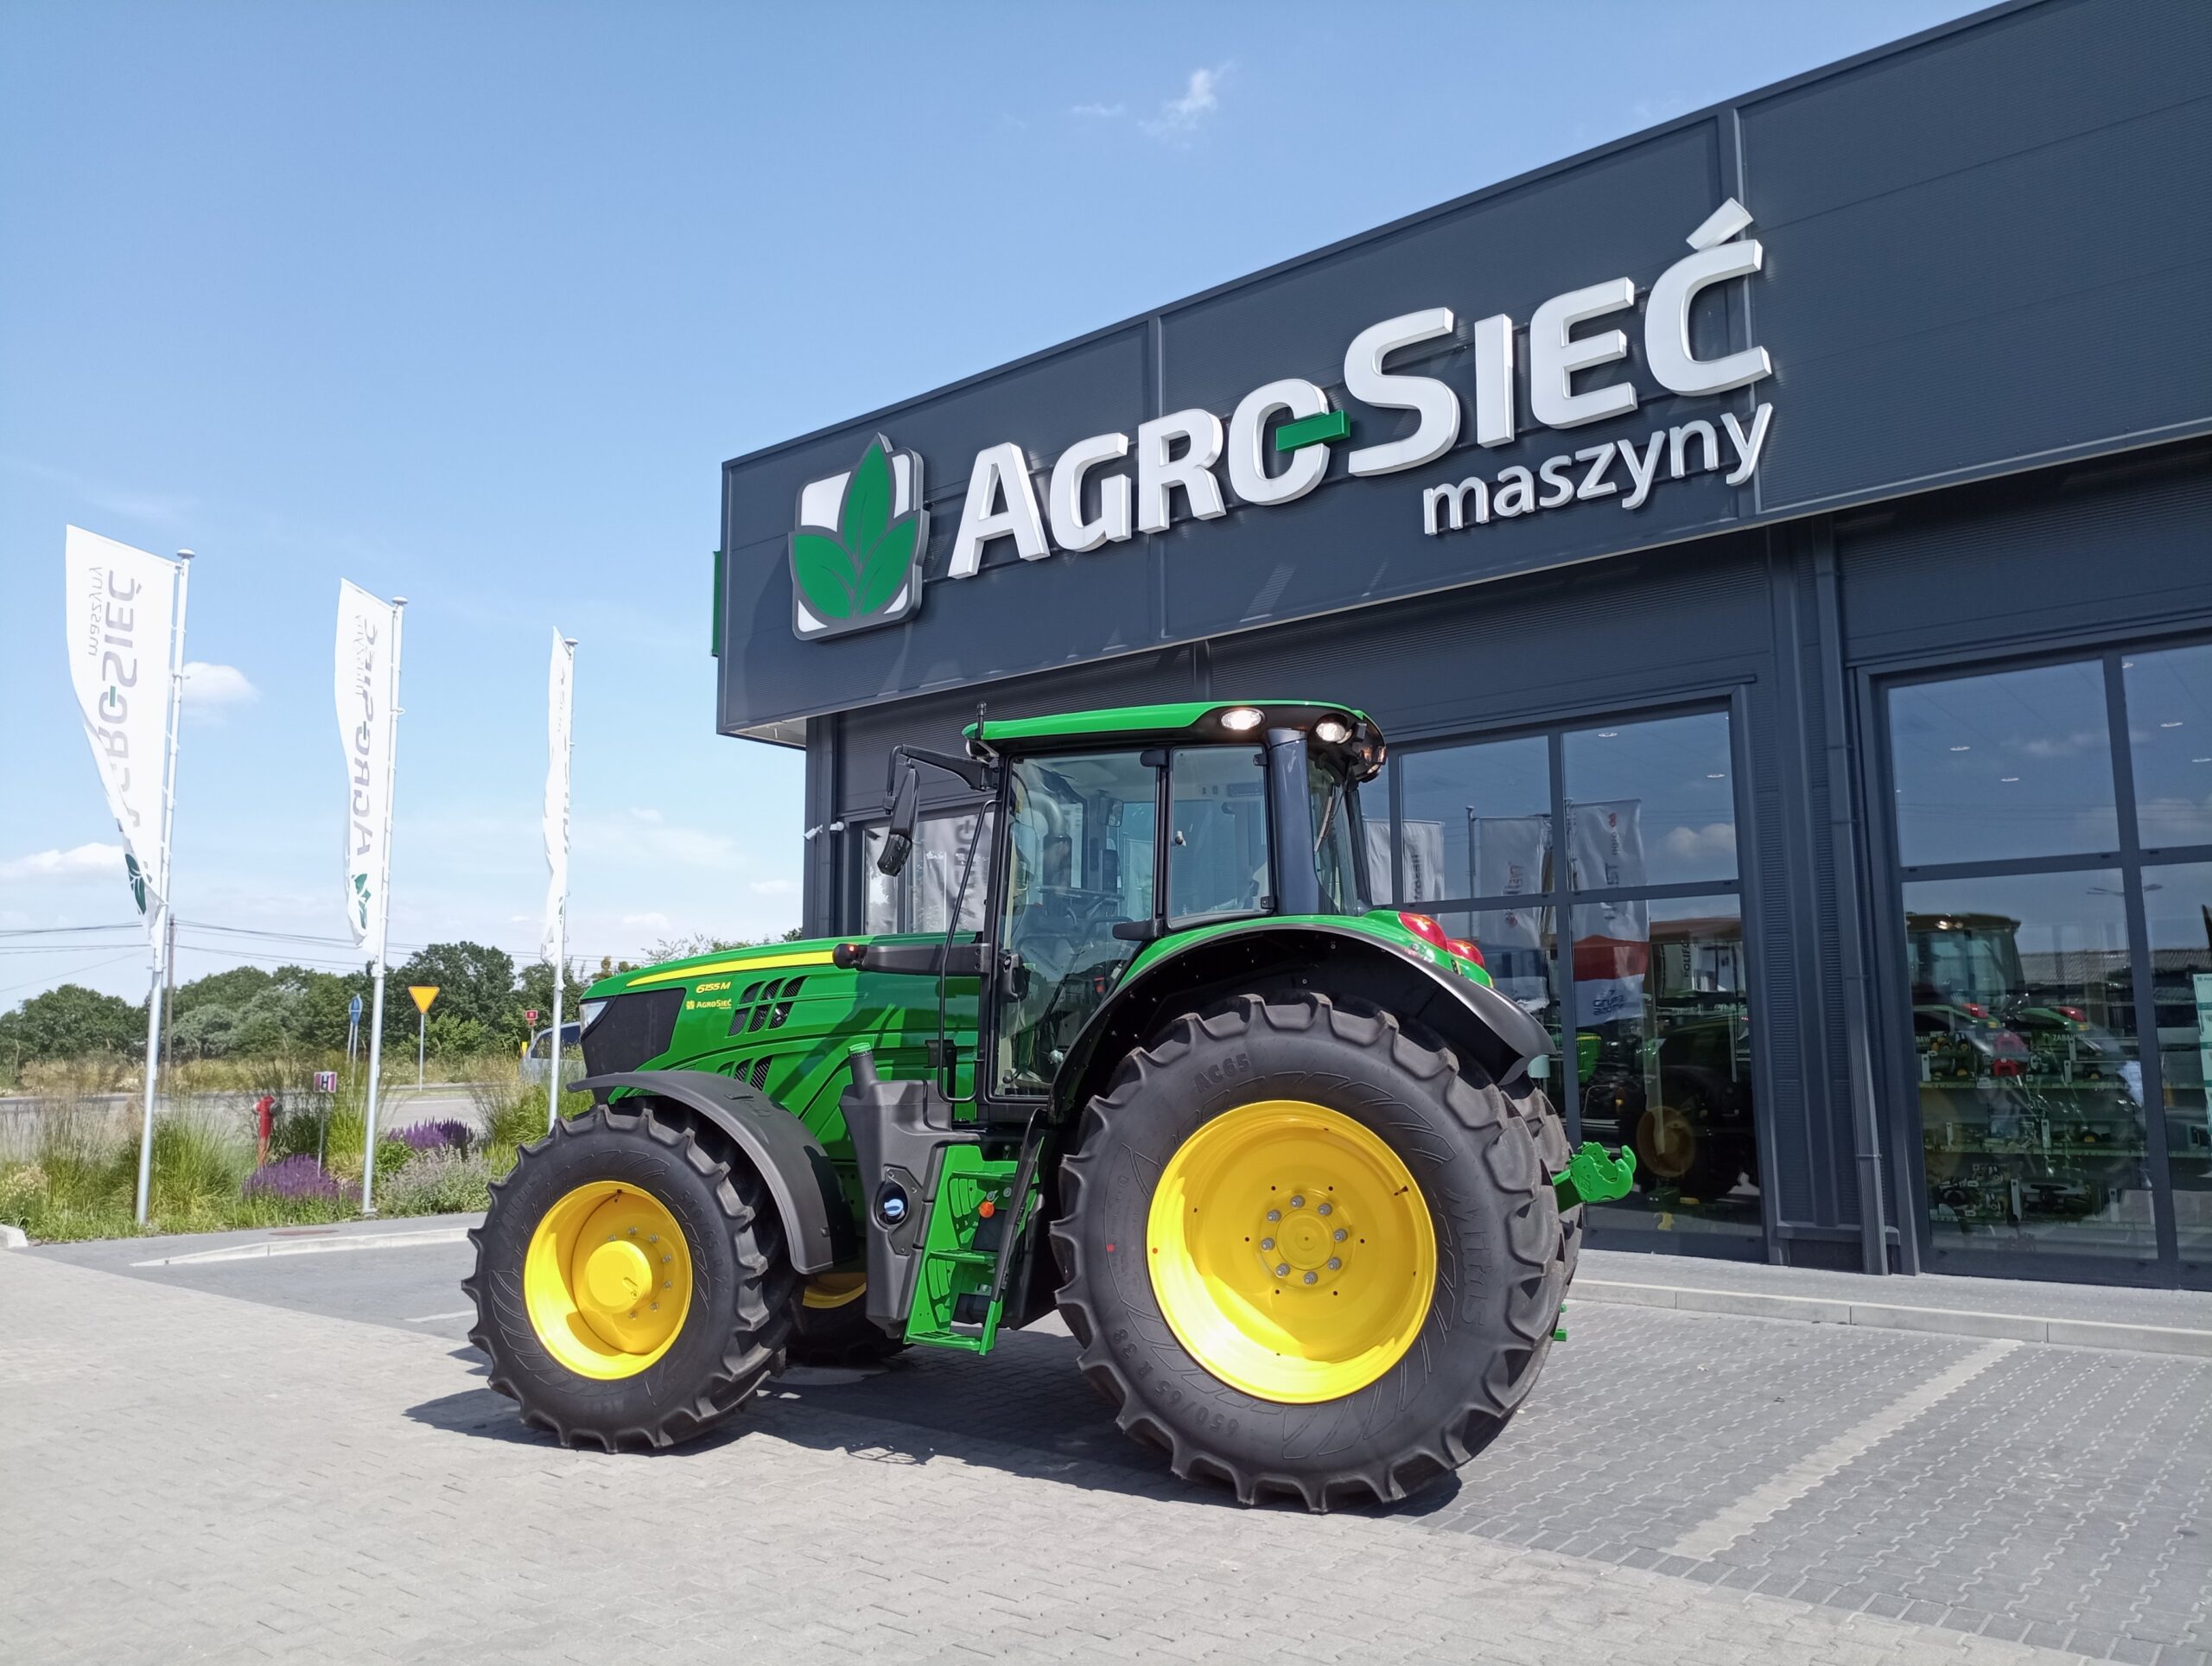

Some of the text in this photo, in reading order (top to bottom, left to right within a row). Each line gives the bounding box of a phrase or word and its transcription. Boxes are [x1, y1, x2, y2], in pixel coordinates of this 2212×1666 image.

[1423, 402, 1774, 536] maszyny
[321, 1075, 329, 1091] H
[1194, 1051, 1251, 1092] AC65
[1113, 1328, 1239, 1437] 650/65 R 38
